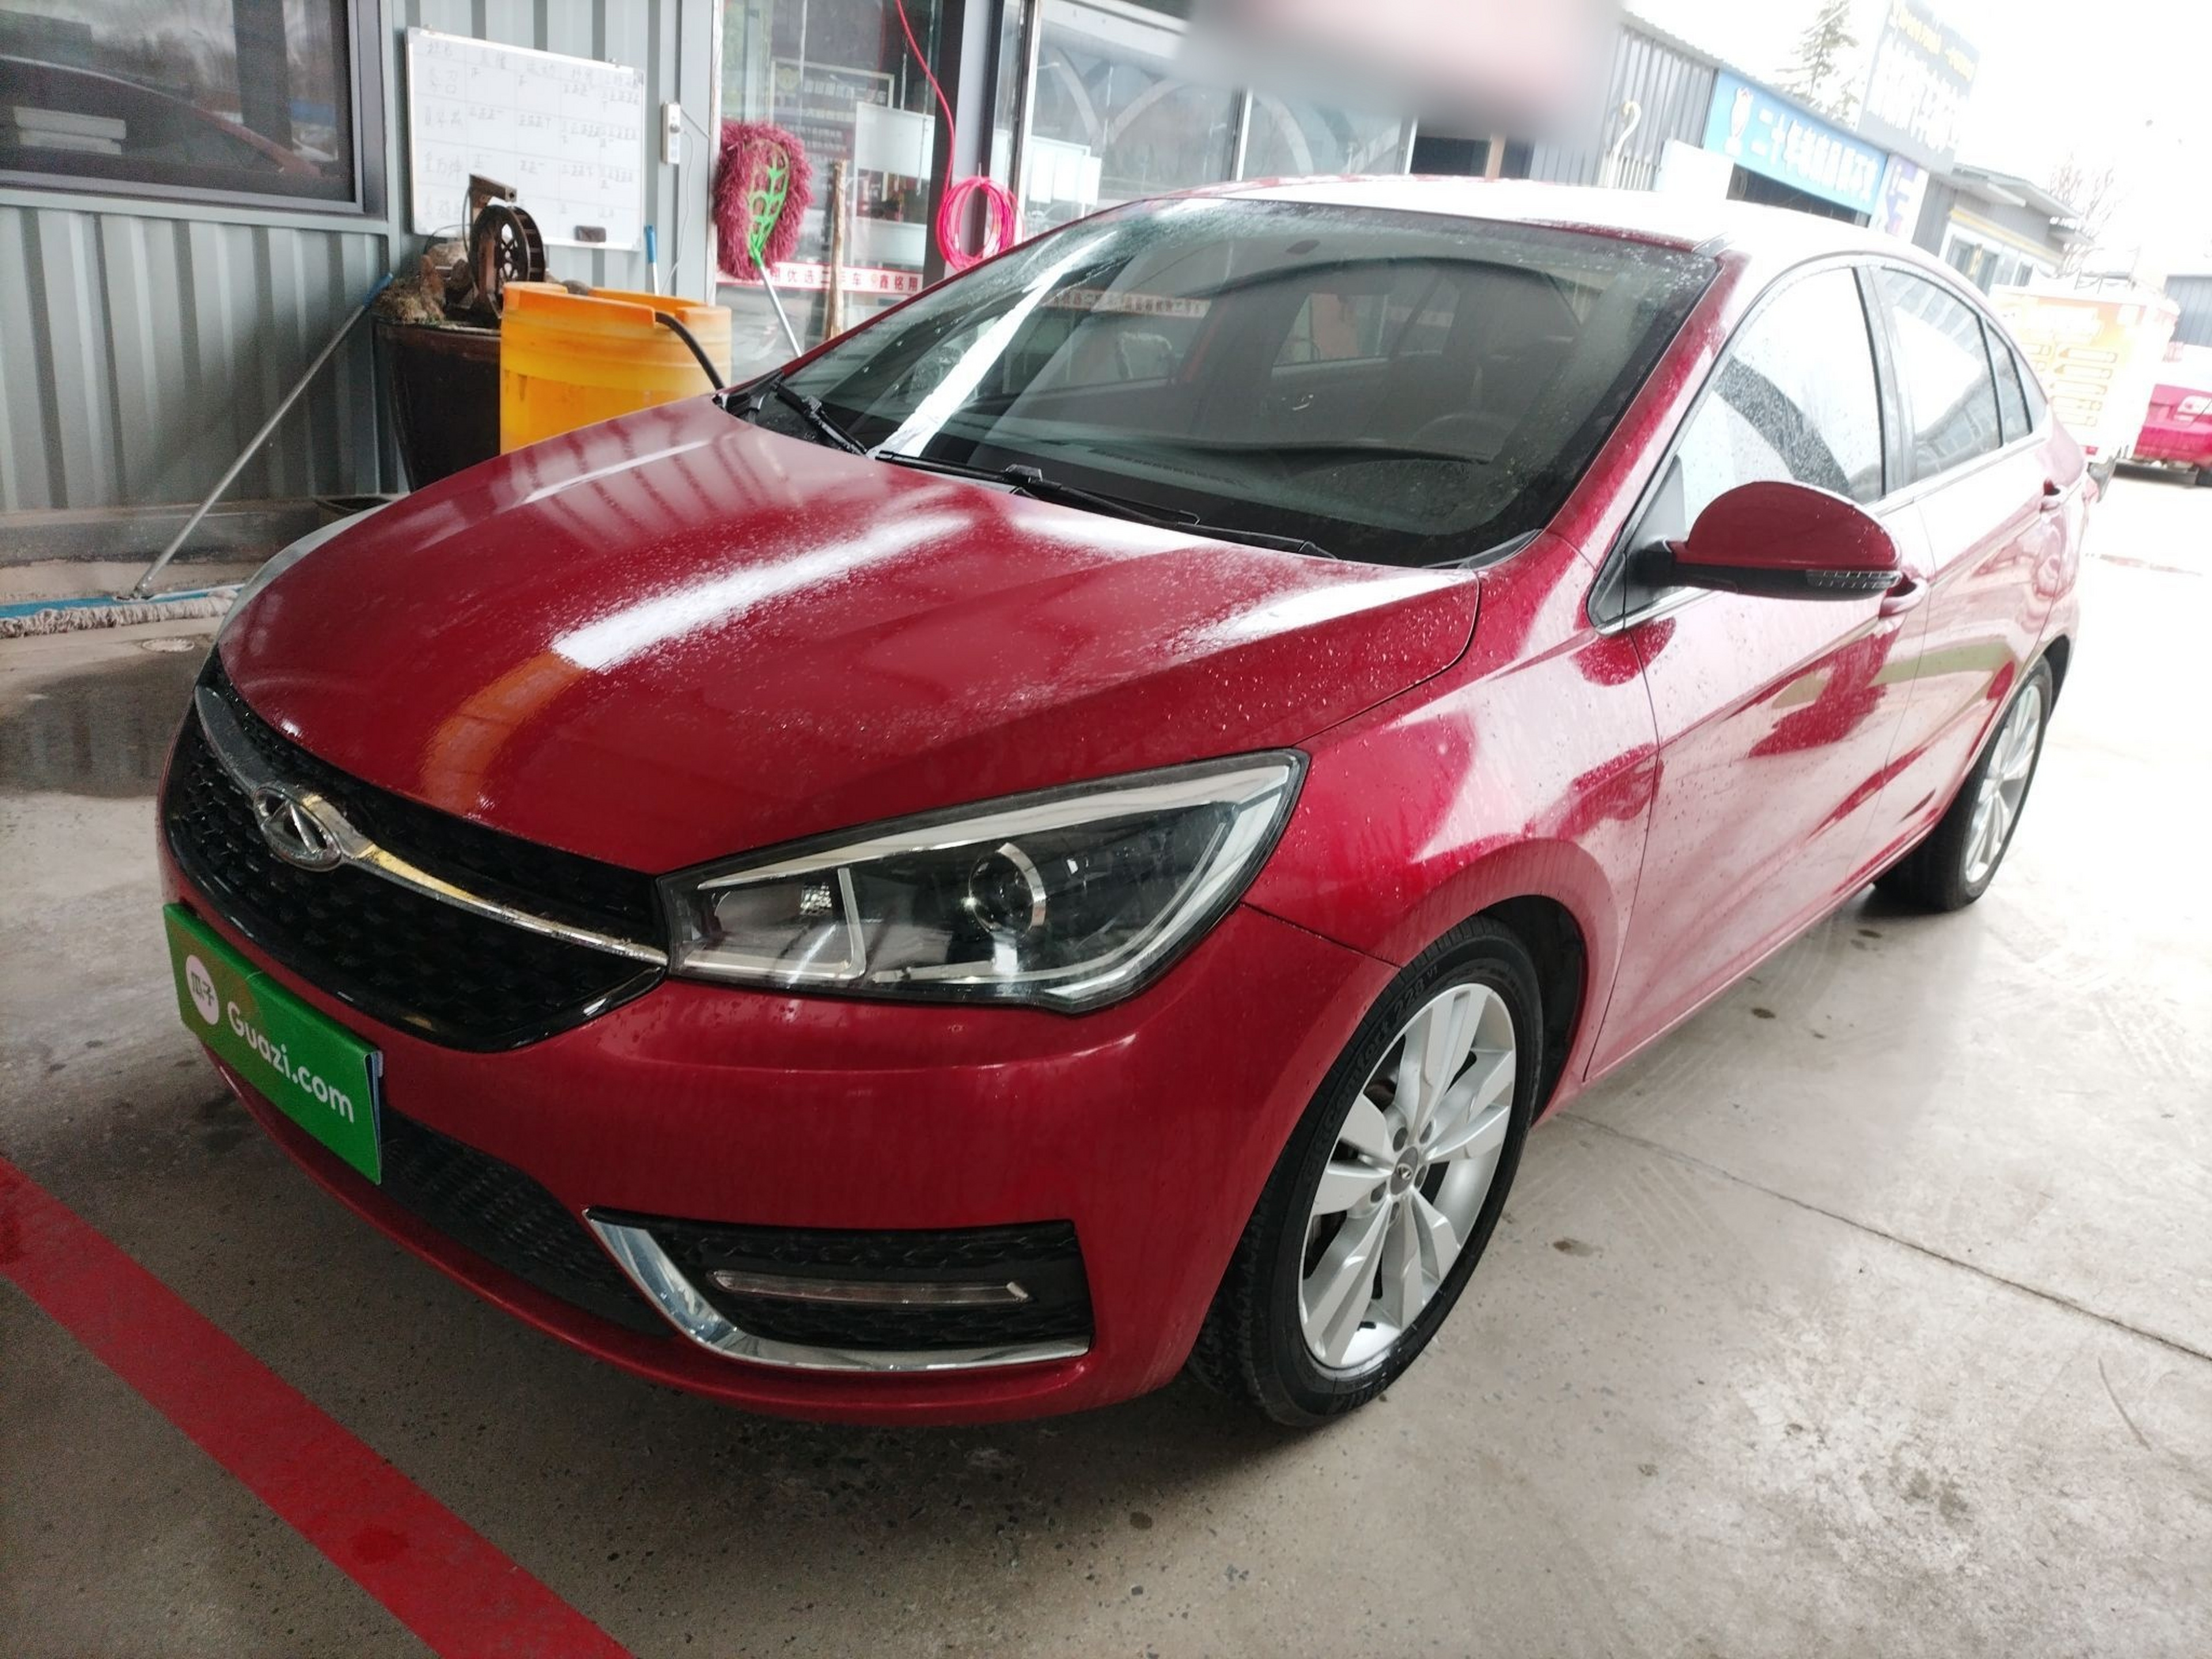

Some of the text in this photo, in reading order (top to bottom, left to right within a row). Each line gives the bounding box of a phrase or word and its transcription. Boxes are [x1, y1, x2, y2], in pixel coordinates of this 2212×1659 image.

[190, 971, 216, 1007] 瓜子
[1393, 973, 1425, 1022] 228
[227, 1001, 355, 1124] Guazi.com
